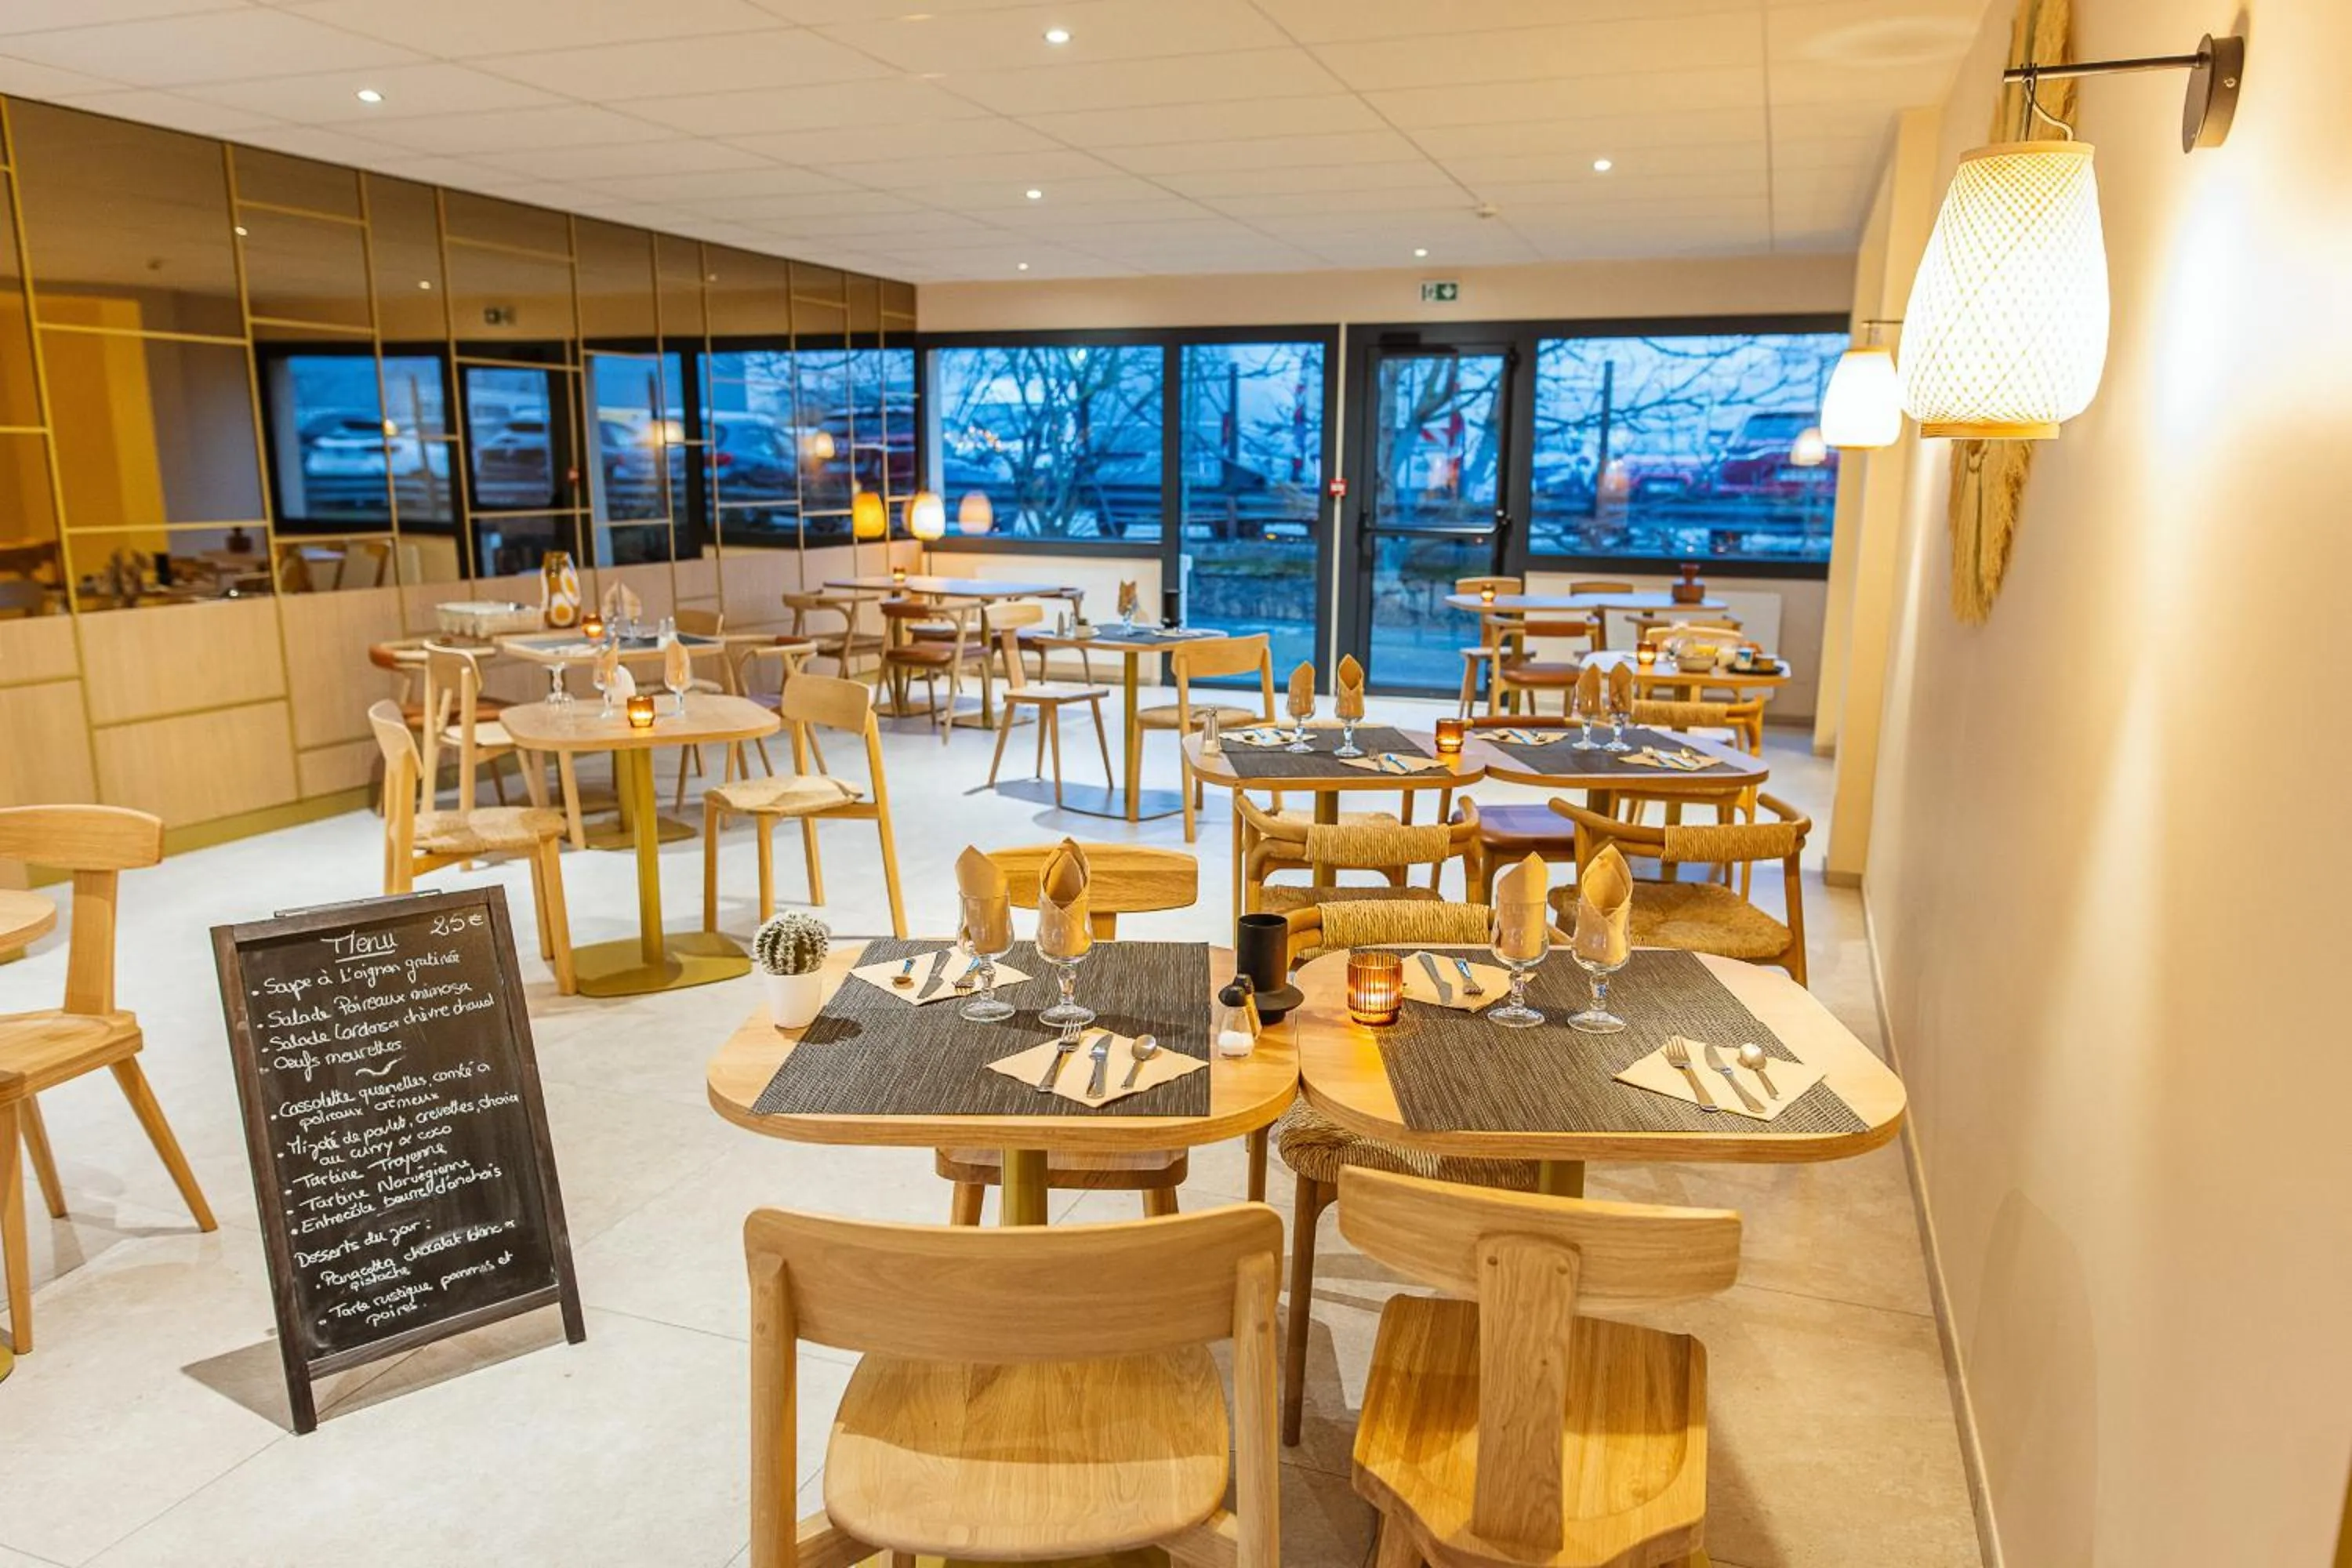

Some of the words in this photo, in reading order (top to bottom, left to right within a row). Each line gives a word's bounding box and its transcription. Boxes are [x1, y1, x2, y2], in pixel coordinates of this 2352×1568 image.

[320, 930, 398, 954] Menu
[318, 968, 333, 985] à
[267, 1006, 332, 1029] Salade
[410, 982, 473, 1001] mimosa
[269, 1030, 332, 1051] Salade
[403, 1007, 451, 1024] chèvre
[452, 993, 495, 1015] chaud
[279, 1089, 356, 1117] Cassolette
[299, 1107, 364, 1132] poireaux
[286, 1130, 340, 1161] Mijoté
[343, 1131, 361, 1144] de
[319, 1155, 345, 1167] au
[350, 1141, 393, 1158] curry
[416, 1125, 452, 1139] coco
[292, 1168, 365, 1188] Tartine
[367, 1143, 448, 1175] Troyenne
[299, 1188, 370, 1211] Tartine
[294, 1240, 361, 1268] Desserts
[364, 1232, 388, 1246] du
[320, 1258, 396, 1287] Panacotta
[403, 1232, 463, 1262] chocolat
[466, 1225, 503, 1242] blanc
[328, 1302, 371, 1318] Tarte
[372, 1282, 434, 1306] rustique
[440, 1260, 495, 1291] pommes
[498, 1250, 514, 1265] et
[350, 1265, 412, 1292] pistache
